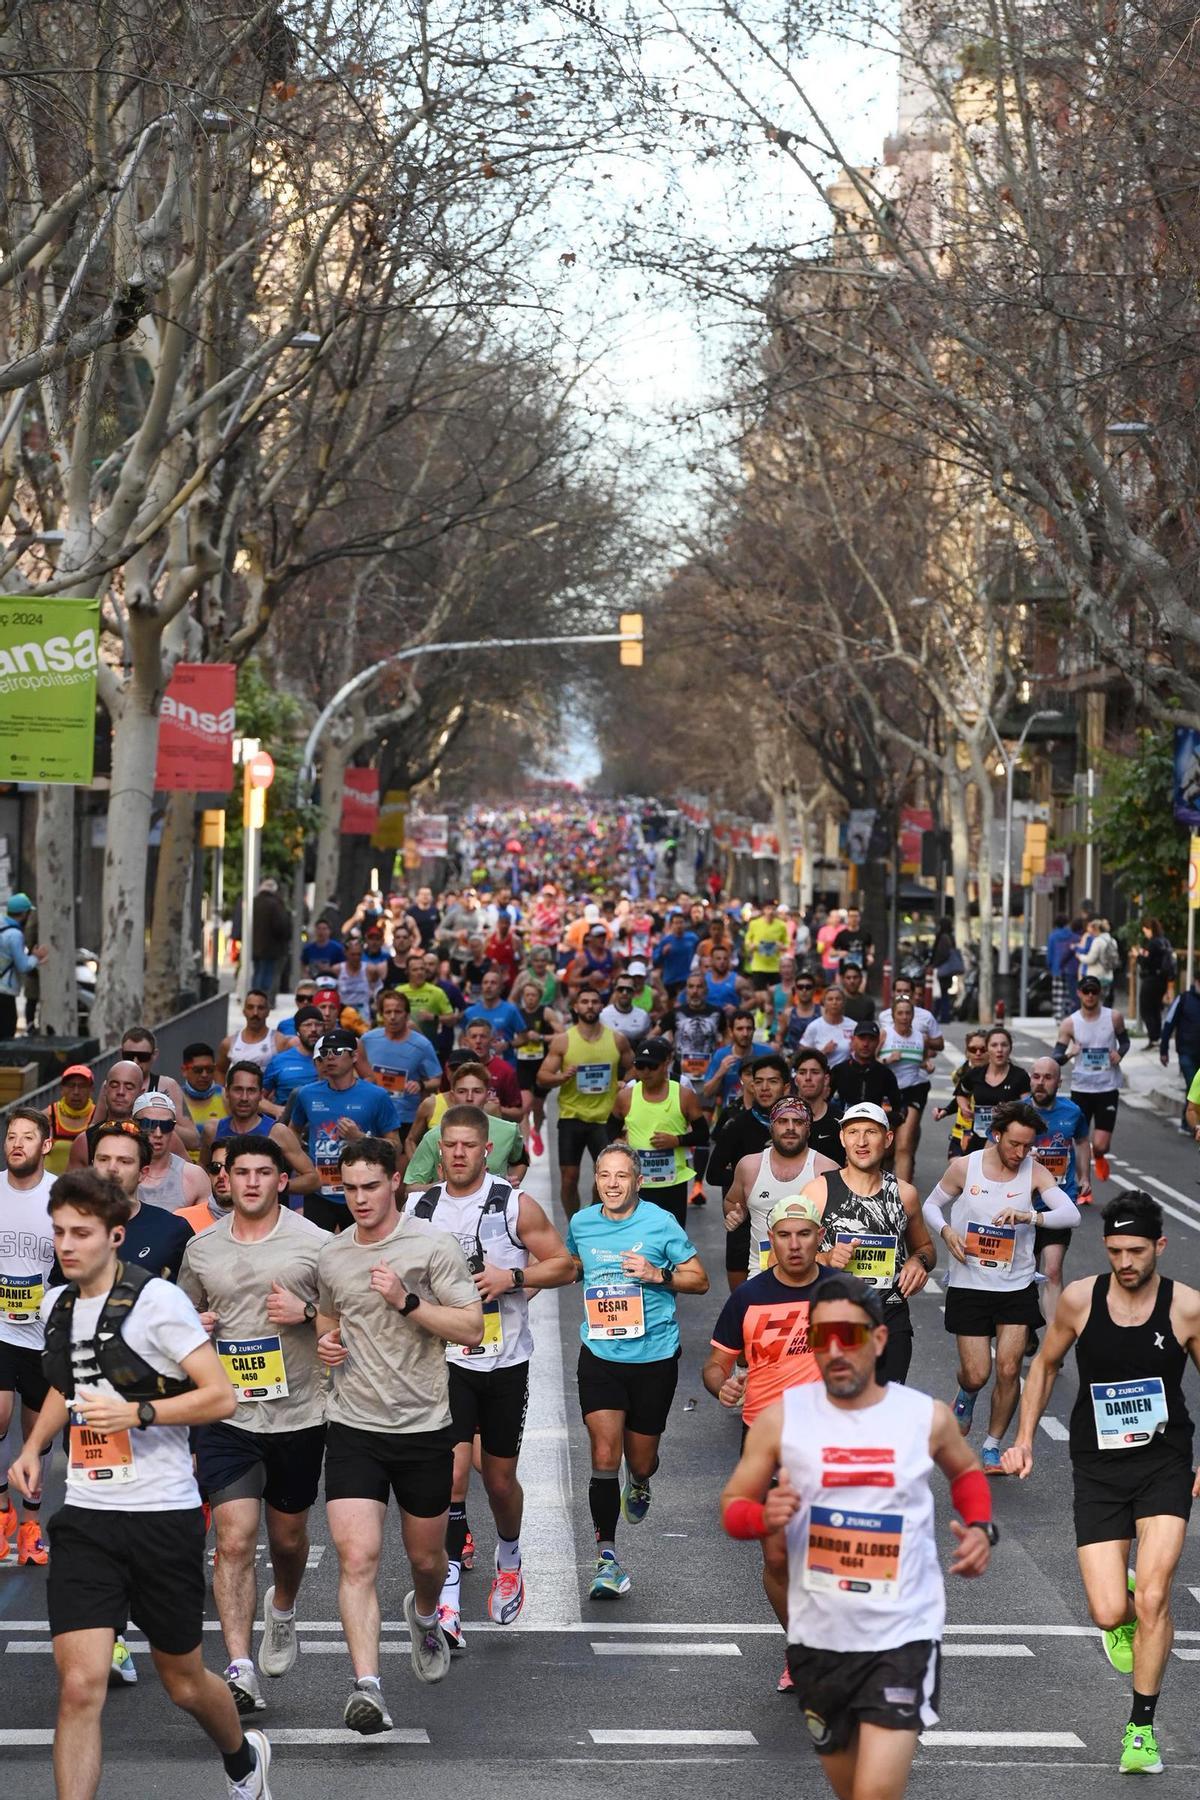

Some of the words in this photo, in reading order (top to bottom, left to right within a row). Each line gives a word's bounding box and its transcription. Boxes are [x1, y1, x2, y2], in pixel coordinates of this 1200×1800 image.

[12, 612, 44, 625] 2024
[978, 1236, 1002, 1248] MATT
[854, 1249, 887, 1262] AKSIM
[0, 1289, 33, 1300] DANIEL
[597, 1299, 629, 1313] CÉSAR
[238, 1344, 263, 1352] ZURICH
[231, 1356, 266, 1371] CALEB
[241, 1372, 258, 1381] 4450
[1118, 1386, 1145, 1395] ZURICH
[1104, 1398, 1153, 1417] DAMIEN
[1121, 1416, 1140, 1426] 1445
[85, 1448, 103, 1460] 2372
[845, 1515, 882, 1529] ZURICH
[855, 1541, 900, 1559] ALONSO
